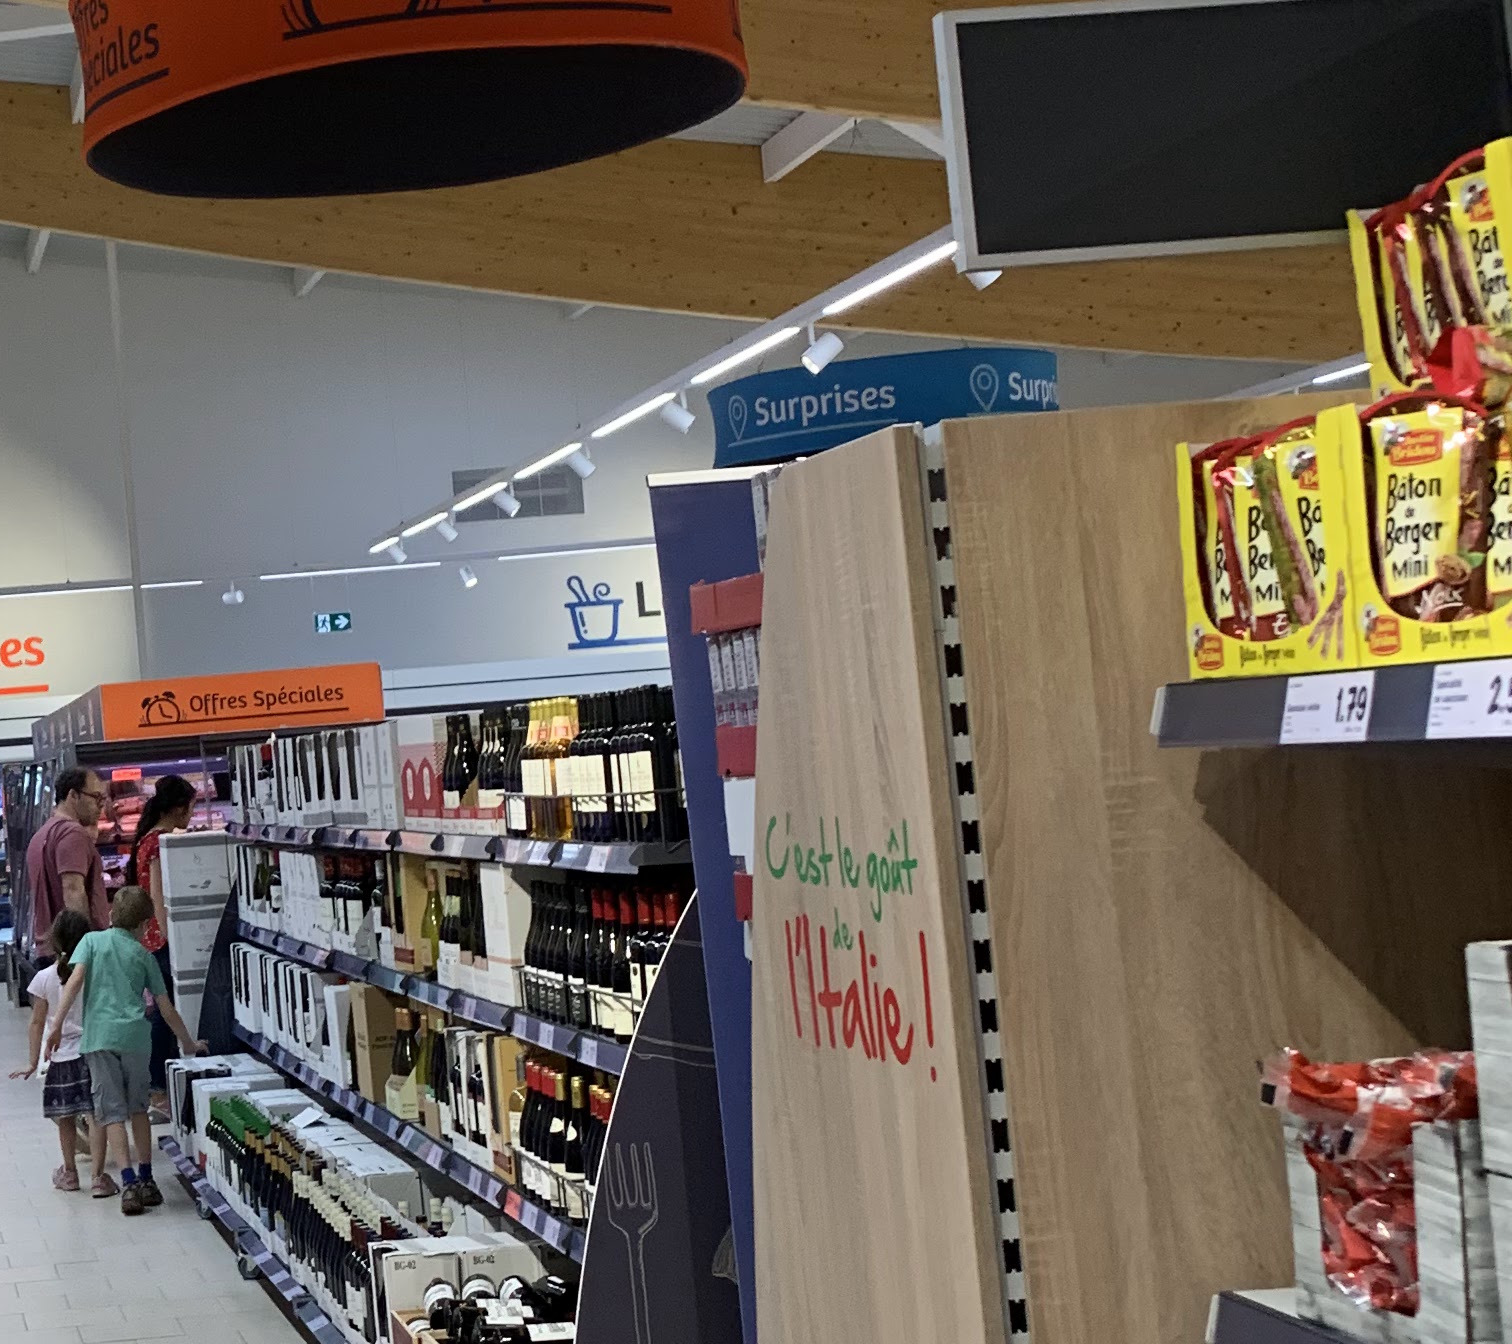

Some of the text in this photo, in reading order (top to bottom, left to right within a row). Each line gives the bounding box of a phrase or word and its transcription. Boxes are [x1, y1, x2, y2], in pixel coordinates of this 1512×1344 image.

[755, 384, 896, 426] Surprises
[1385, 517, 1444, 558] Berger
[1392, 555, 1429, 582] Mini
[635, 580, 662, 618] L
[190, 684, 344, 716] Offres Spéciales
[1336, 686, 1368, 723] 1.79
[765, 812, 918, 923] C'est le goût
[833, 907, 853, 950] de
[394, 1260, 417, 1271] BG-02
